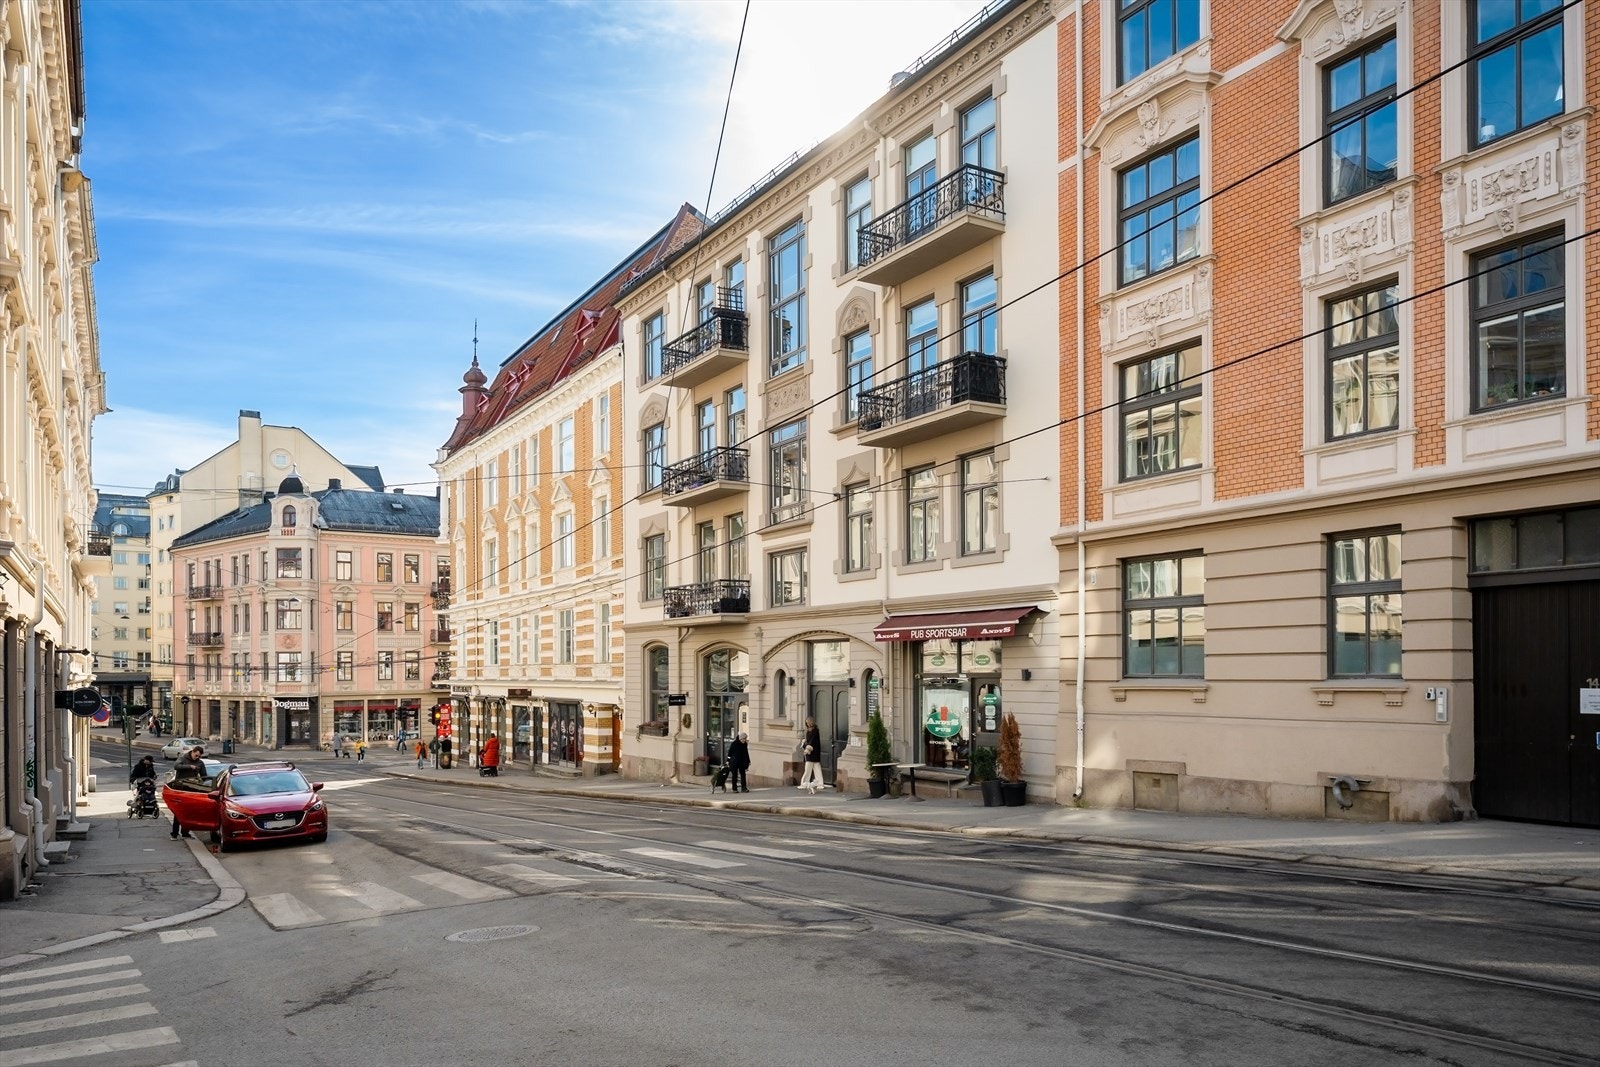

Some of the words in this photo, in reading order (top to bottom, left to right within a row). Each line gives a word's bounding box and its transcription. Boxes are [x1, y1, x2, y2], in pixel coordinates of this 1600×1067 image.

[911, 630, 924, 639] PUB
[925, 628, 967, 638] SPORTSBAR
[272, 699, 310, 709] Dogman
